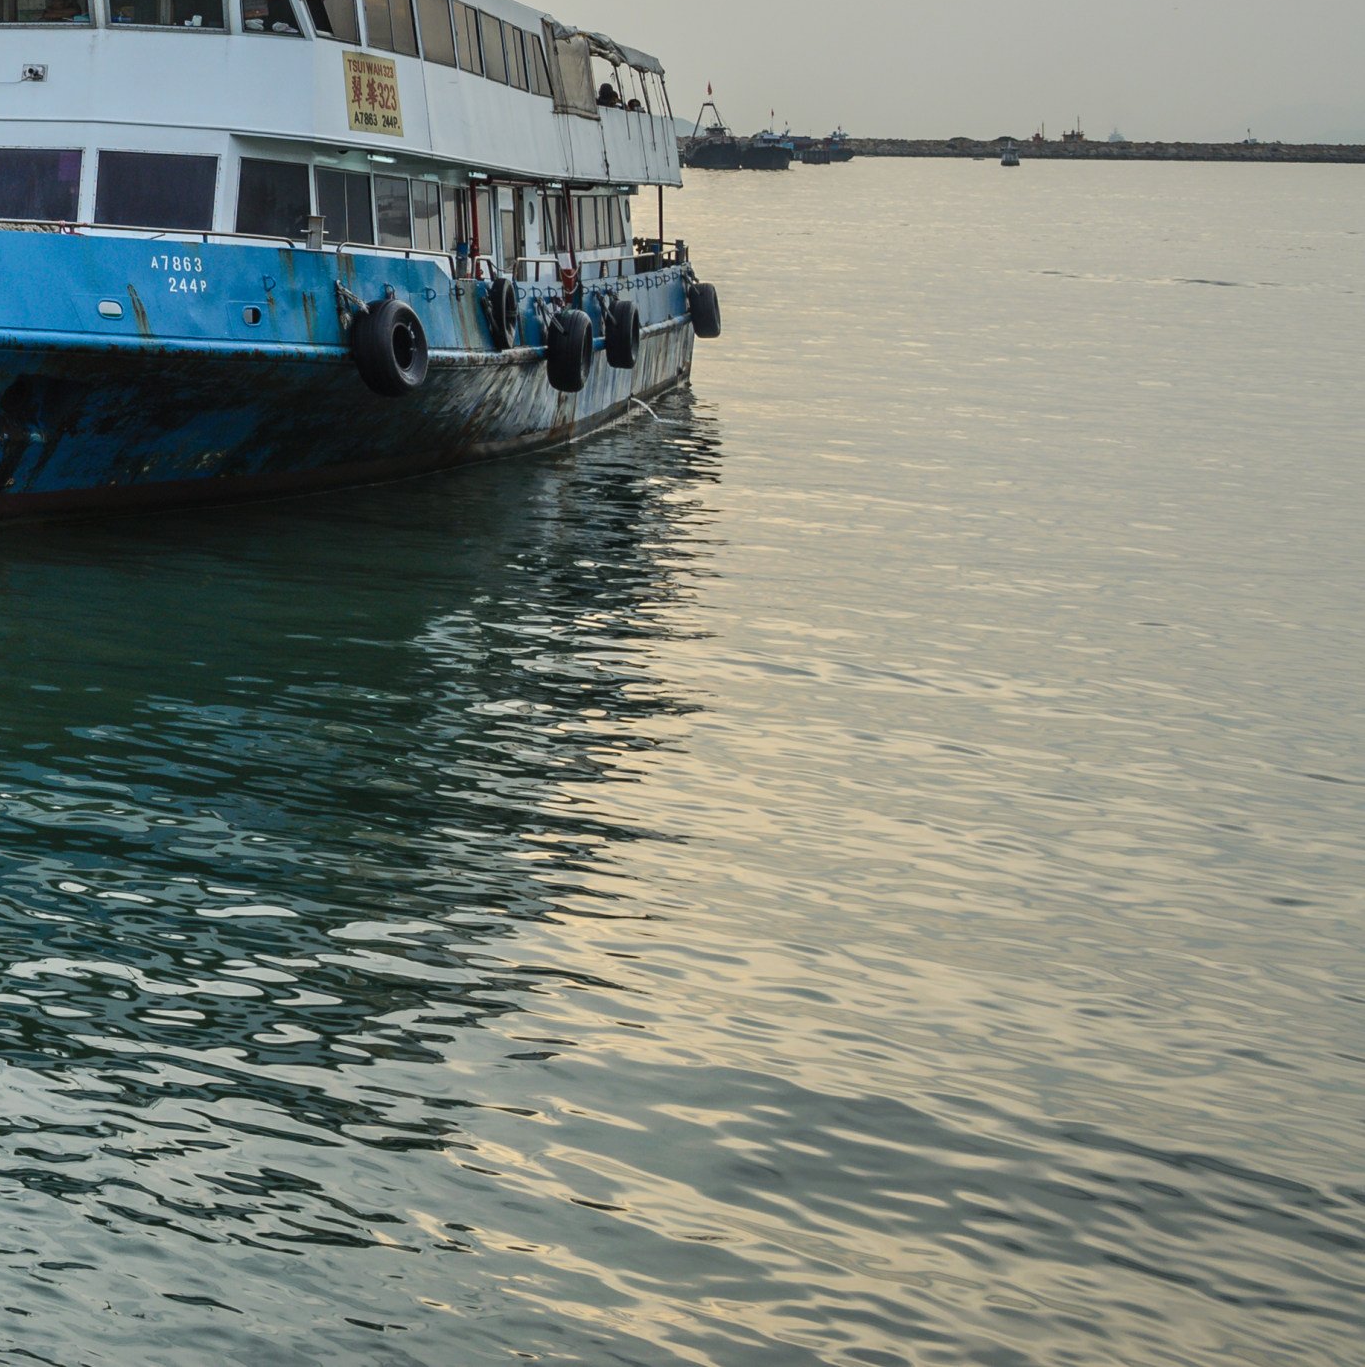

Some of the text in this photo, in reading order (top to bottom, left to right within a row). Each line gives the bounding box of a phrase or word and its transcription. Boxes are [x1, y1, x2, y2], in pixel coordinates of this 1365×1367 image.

[347, 58, 395, 79] TSUI WAH 323
[354, 111, 378, 126] A7863
[151, 255, 203, 273] A7863
[168, 276, 207, 294] 244P
